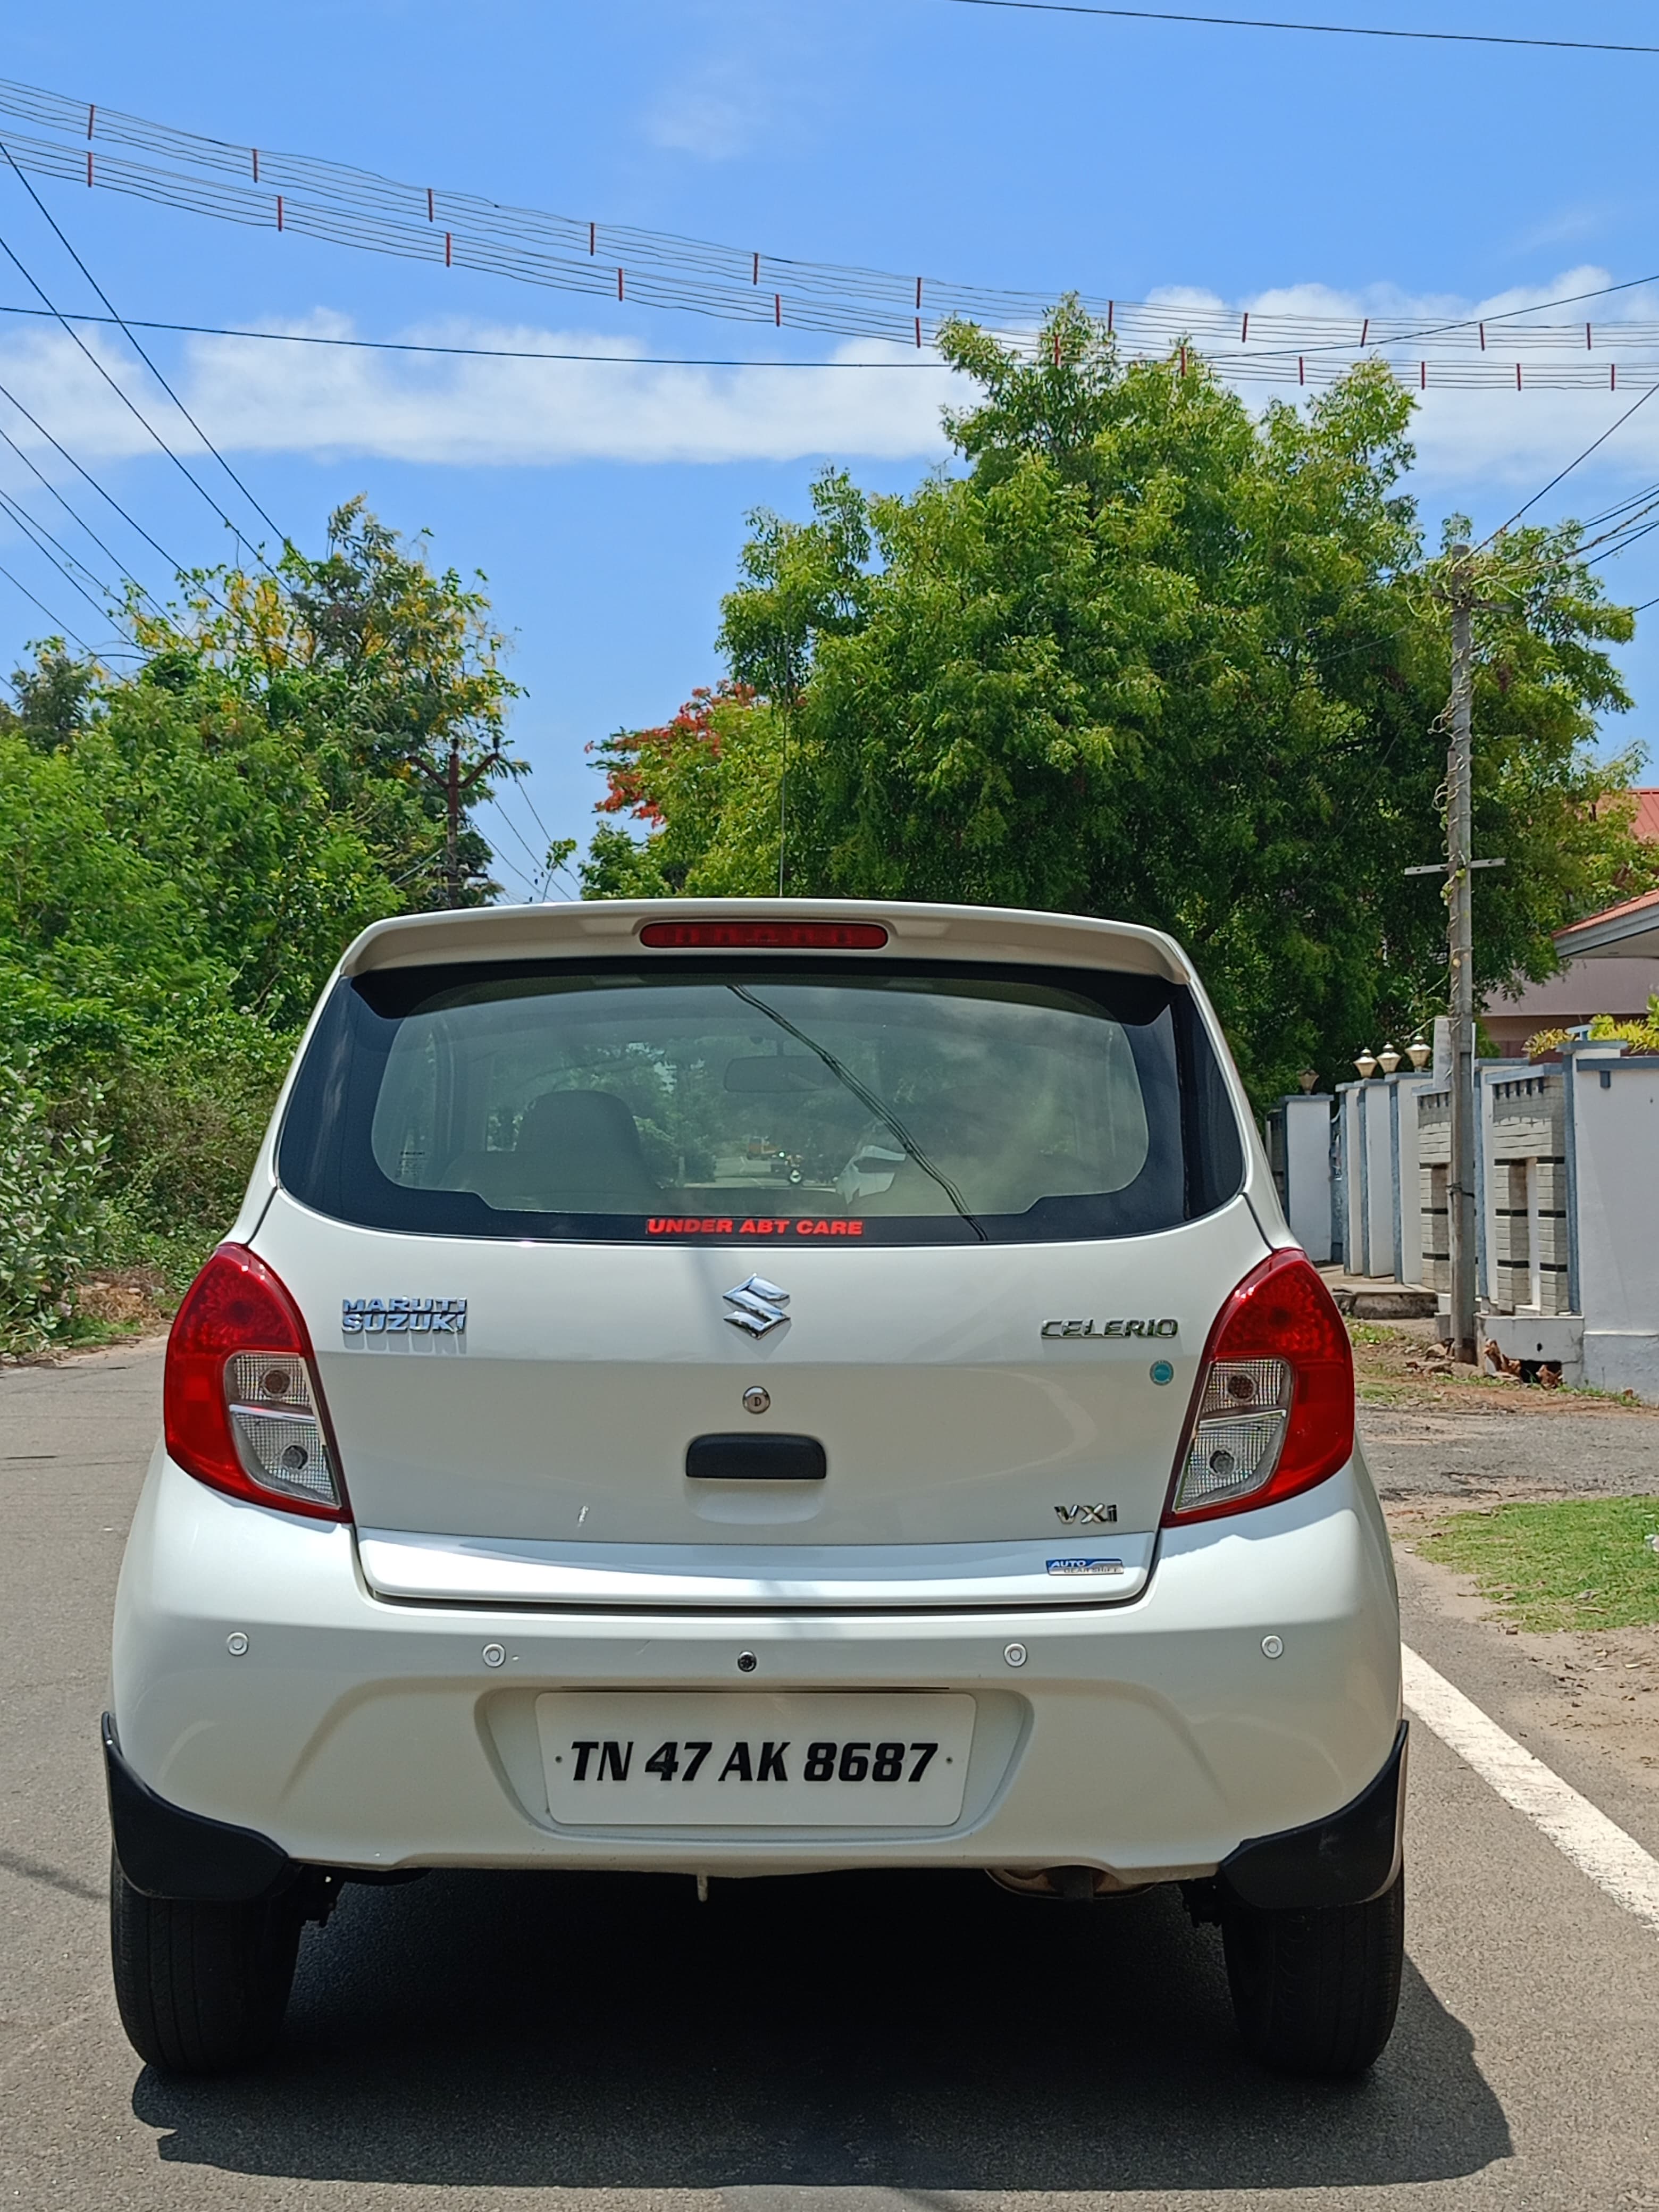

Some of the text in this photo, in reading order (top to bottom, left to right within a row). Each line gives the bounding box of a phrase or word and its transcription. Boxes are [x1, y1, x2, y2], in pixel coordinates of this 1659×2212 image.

[648, 1218, 863, 1235] UNDER ABT CARE
[342, 1297, 467, 1312] MARUTI
[342, 1313, 466, 1334] SUZUKI
[1041, 1319, 1178, 1338] CELERIO
[1054, 1503, 1118, 1524] VXi
[1050, 1560, 1086, 1569] AUTO
[571, 1741, 939, 1783] TN 47 AK 8687
